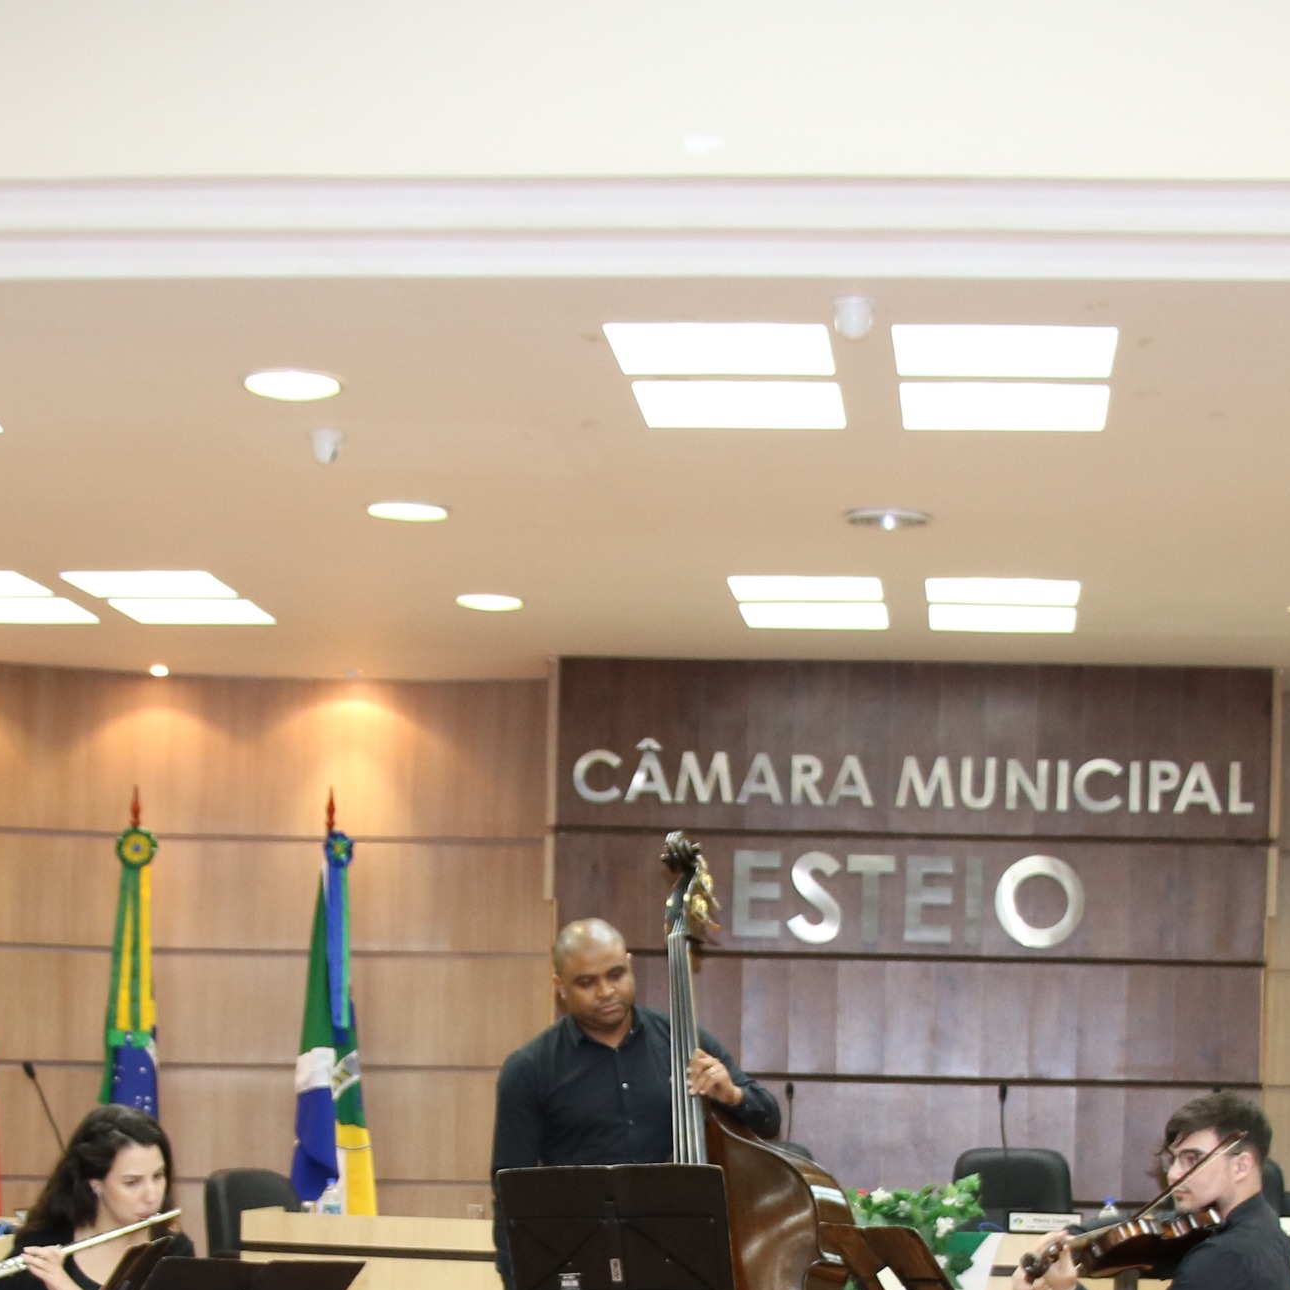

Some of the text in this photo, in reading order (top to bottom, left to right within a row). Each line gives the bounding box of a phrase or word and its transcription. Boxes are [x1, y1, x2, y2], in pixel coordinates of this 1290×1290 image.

[572, 737, 1255, 814] CÂMARA MUNICIPAL
[731, 850, 1085, 949] ESTEIO
